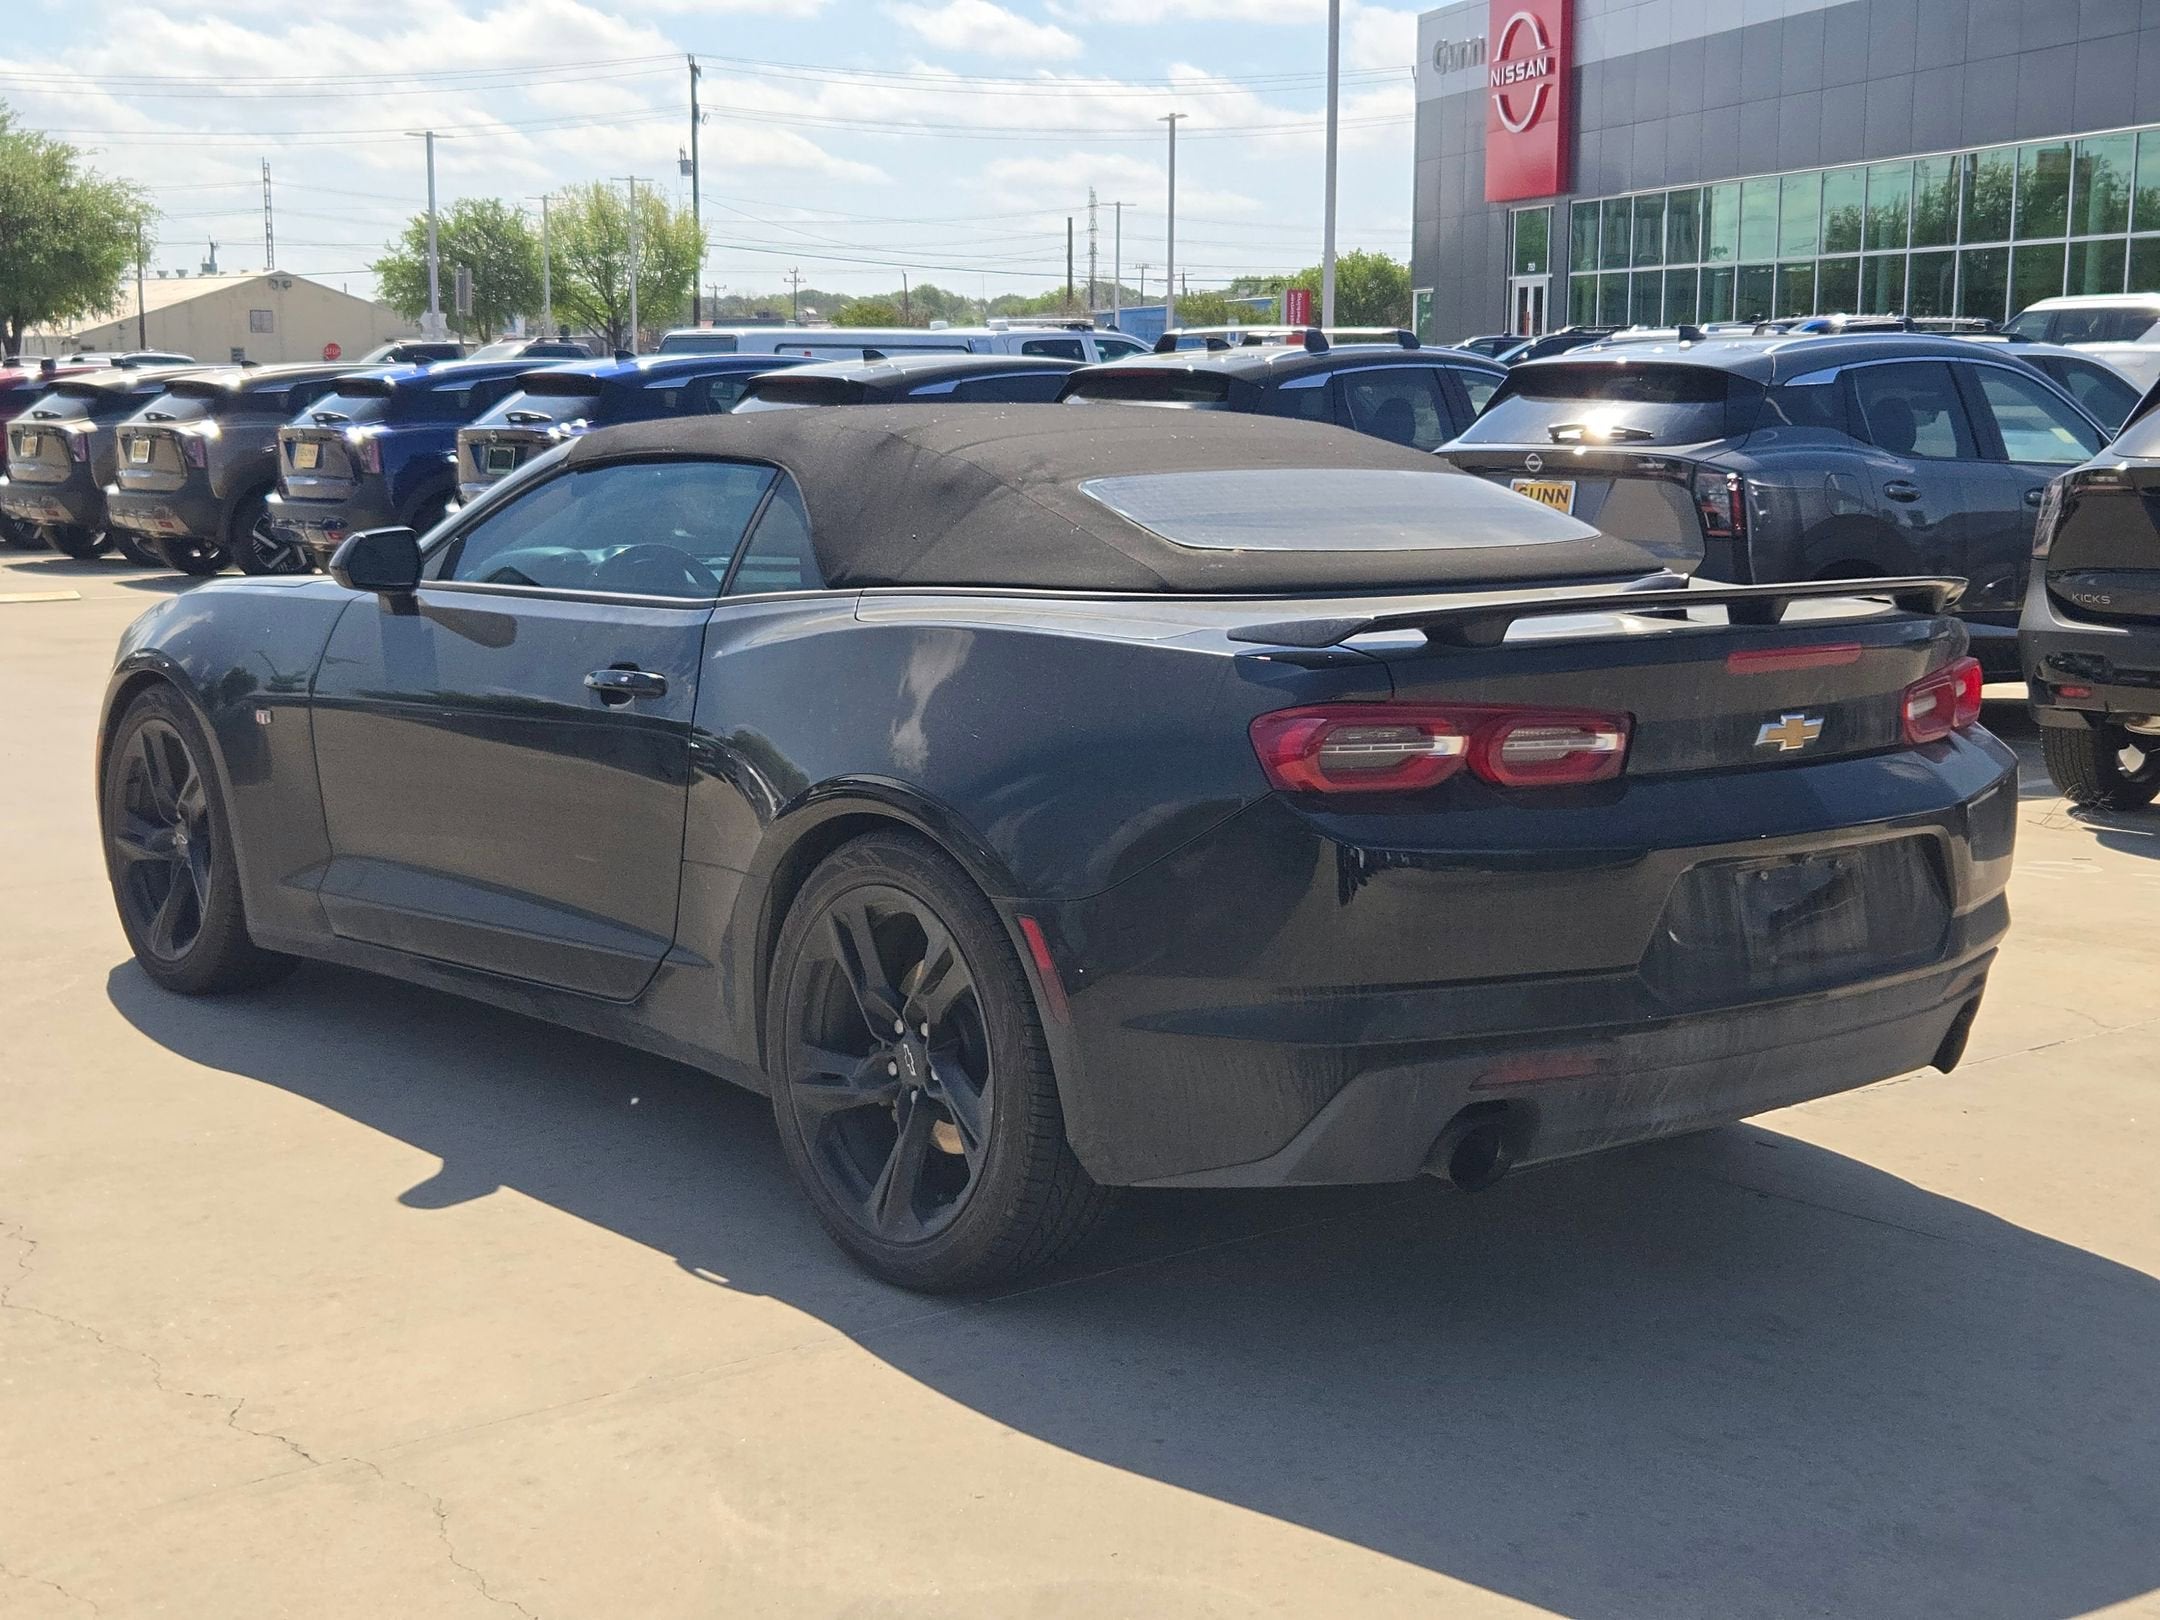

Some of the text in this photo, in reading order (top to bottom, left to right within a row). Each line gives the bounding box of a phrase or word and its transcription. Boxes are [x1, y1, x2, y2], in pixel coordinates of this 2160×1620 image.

[1433, 37, 1487, 75] Gunn
[1490, 56, 1547, 88] NISSAN
[2072, 593, 2111, 604] KICKS
